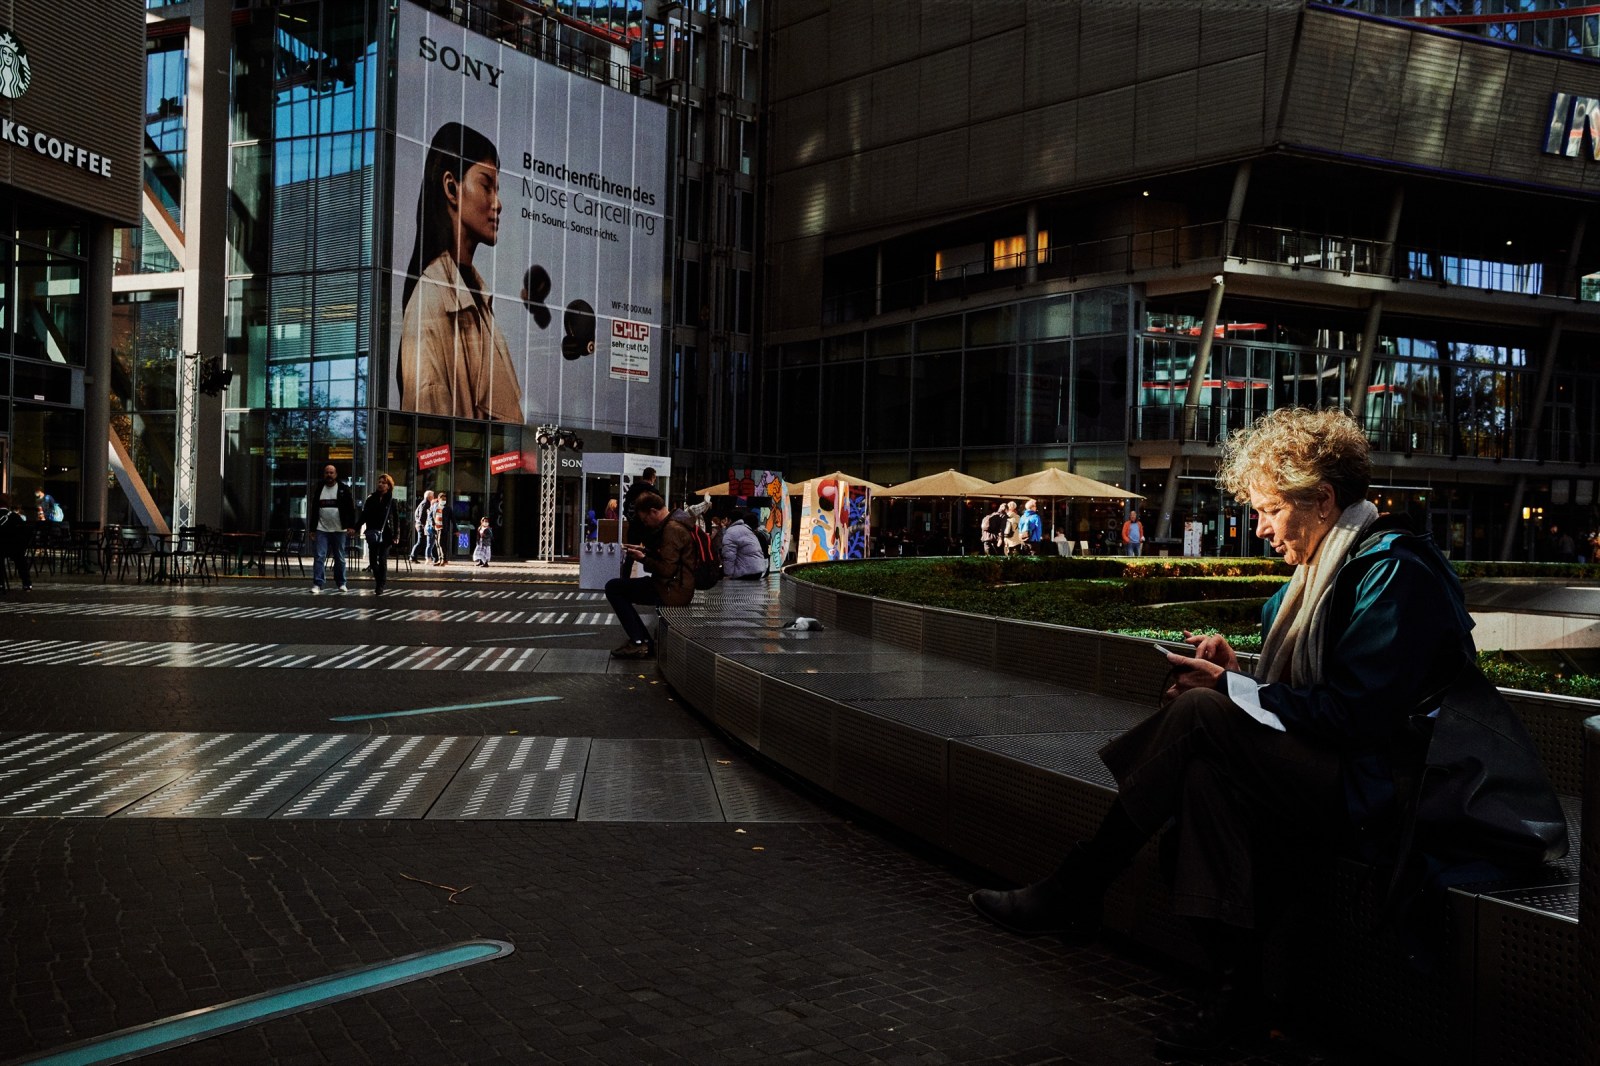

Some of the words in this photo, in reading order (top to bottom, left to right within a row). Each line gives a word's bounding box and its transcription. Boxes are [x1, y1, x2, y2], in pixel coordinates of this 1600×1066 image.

[419, 36, 504, 88] SONY
[2, 118, 29, 147] KS
[34, 132, 111, 178] COFFEE
[522, 176, 568, 209] Noise
[523, 152, 656, 206] Branchenführendes
[521, 207, 541, 223] Dein
[570, 221, 593, 237] Sonst
[613, 321, 648, 339] CHIP
[611, 341, 625, 349] sehr
[626, 343, 637, 351] gut
[637, 344, 649, 353] (1,2)
